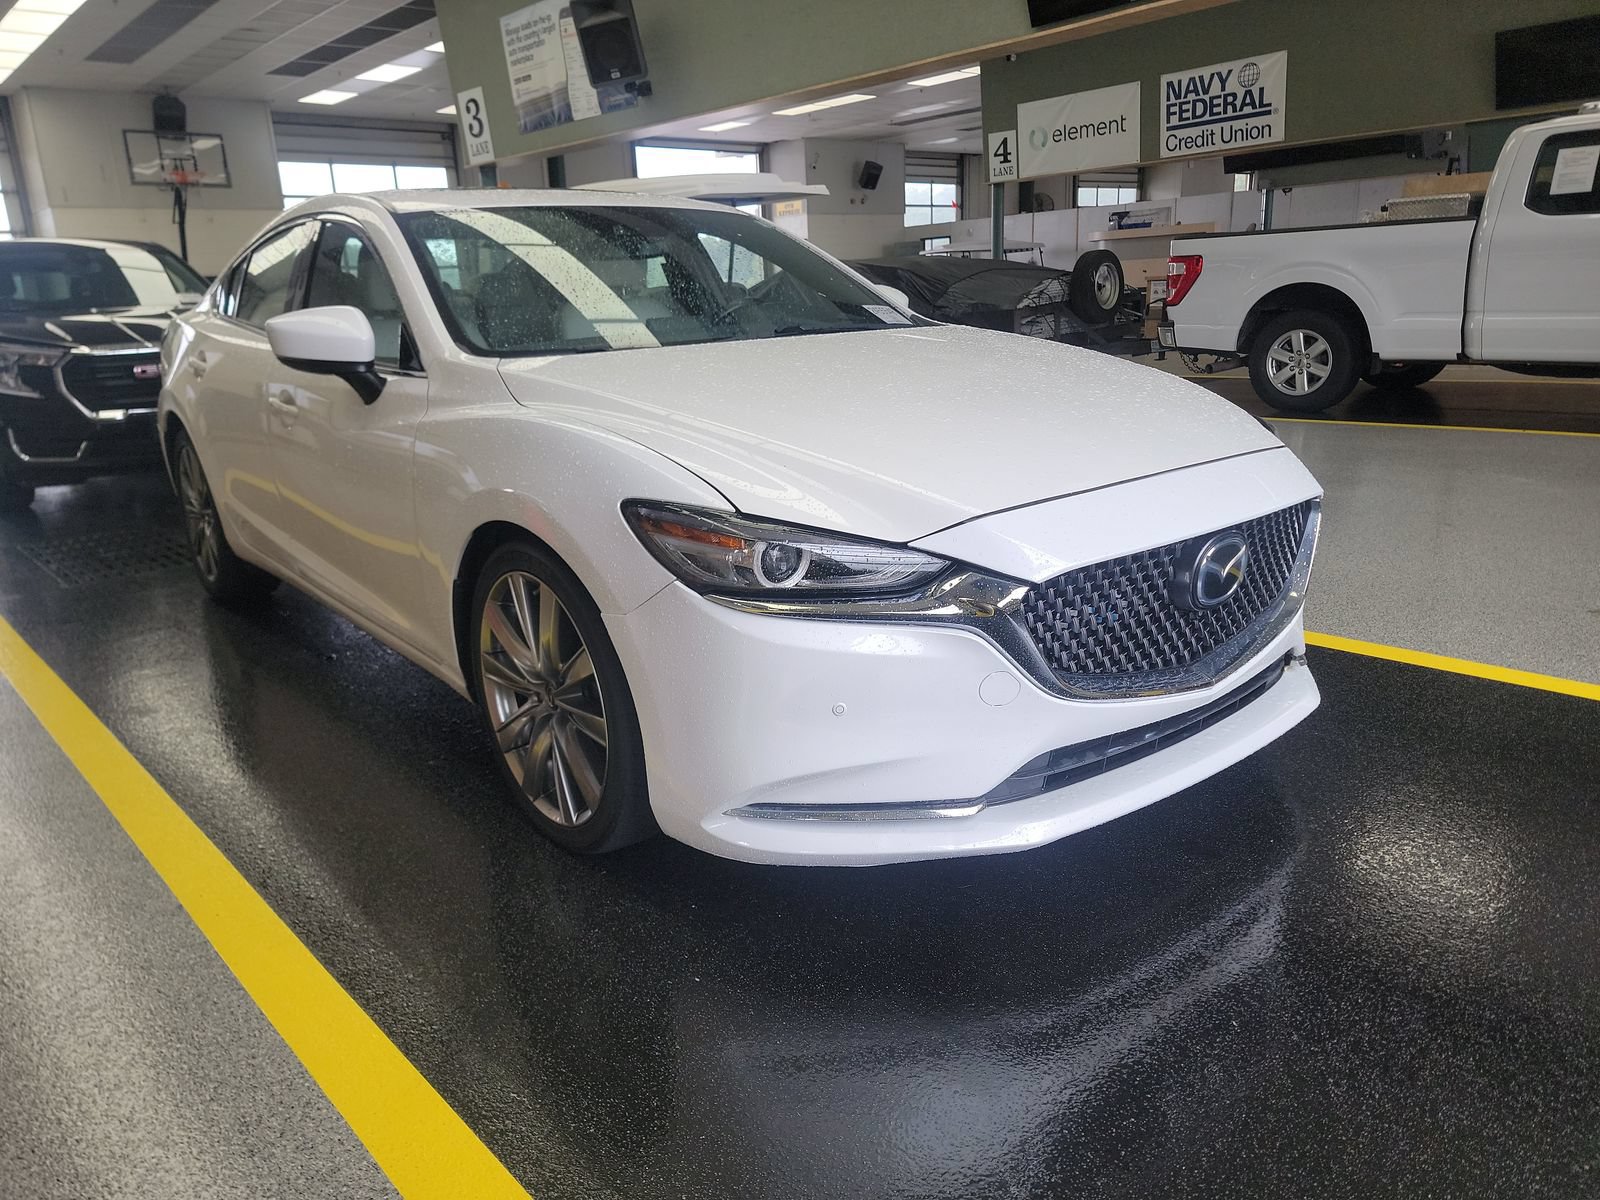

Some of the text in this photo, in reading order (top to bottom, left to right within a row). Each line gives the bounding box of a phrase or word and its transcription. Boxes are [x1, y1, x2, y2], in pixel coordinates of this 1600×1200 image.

[1166, 68, 1233, 102] NAVY
[465, 97, 484, 138] 3
[1166, 86, 1272, 125] FEDERAL
[1052, 114, 1127, 143] element
[1165, 122, 1272, 152] Credit Union
[470, 141, 490, 157] LANE
[993, 136, 1012, 164] 4
[993, 166, 1014, 177] LANE
